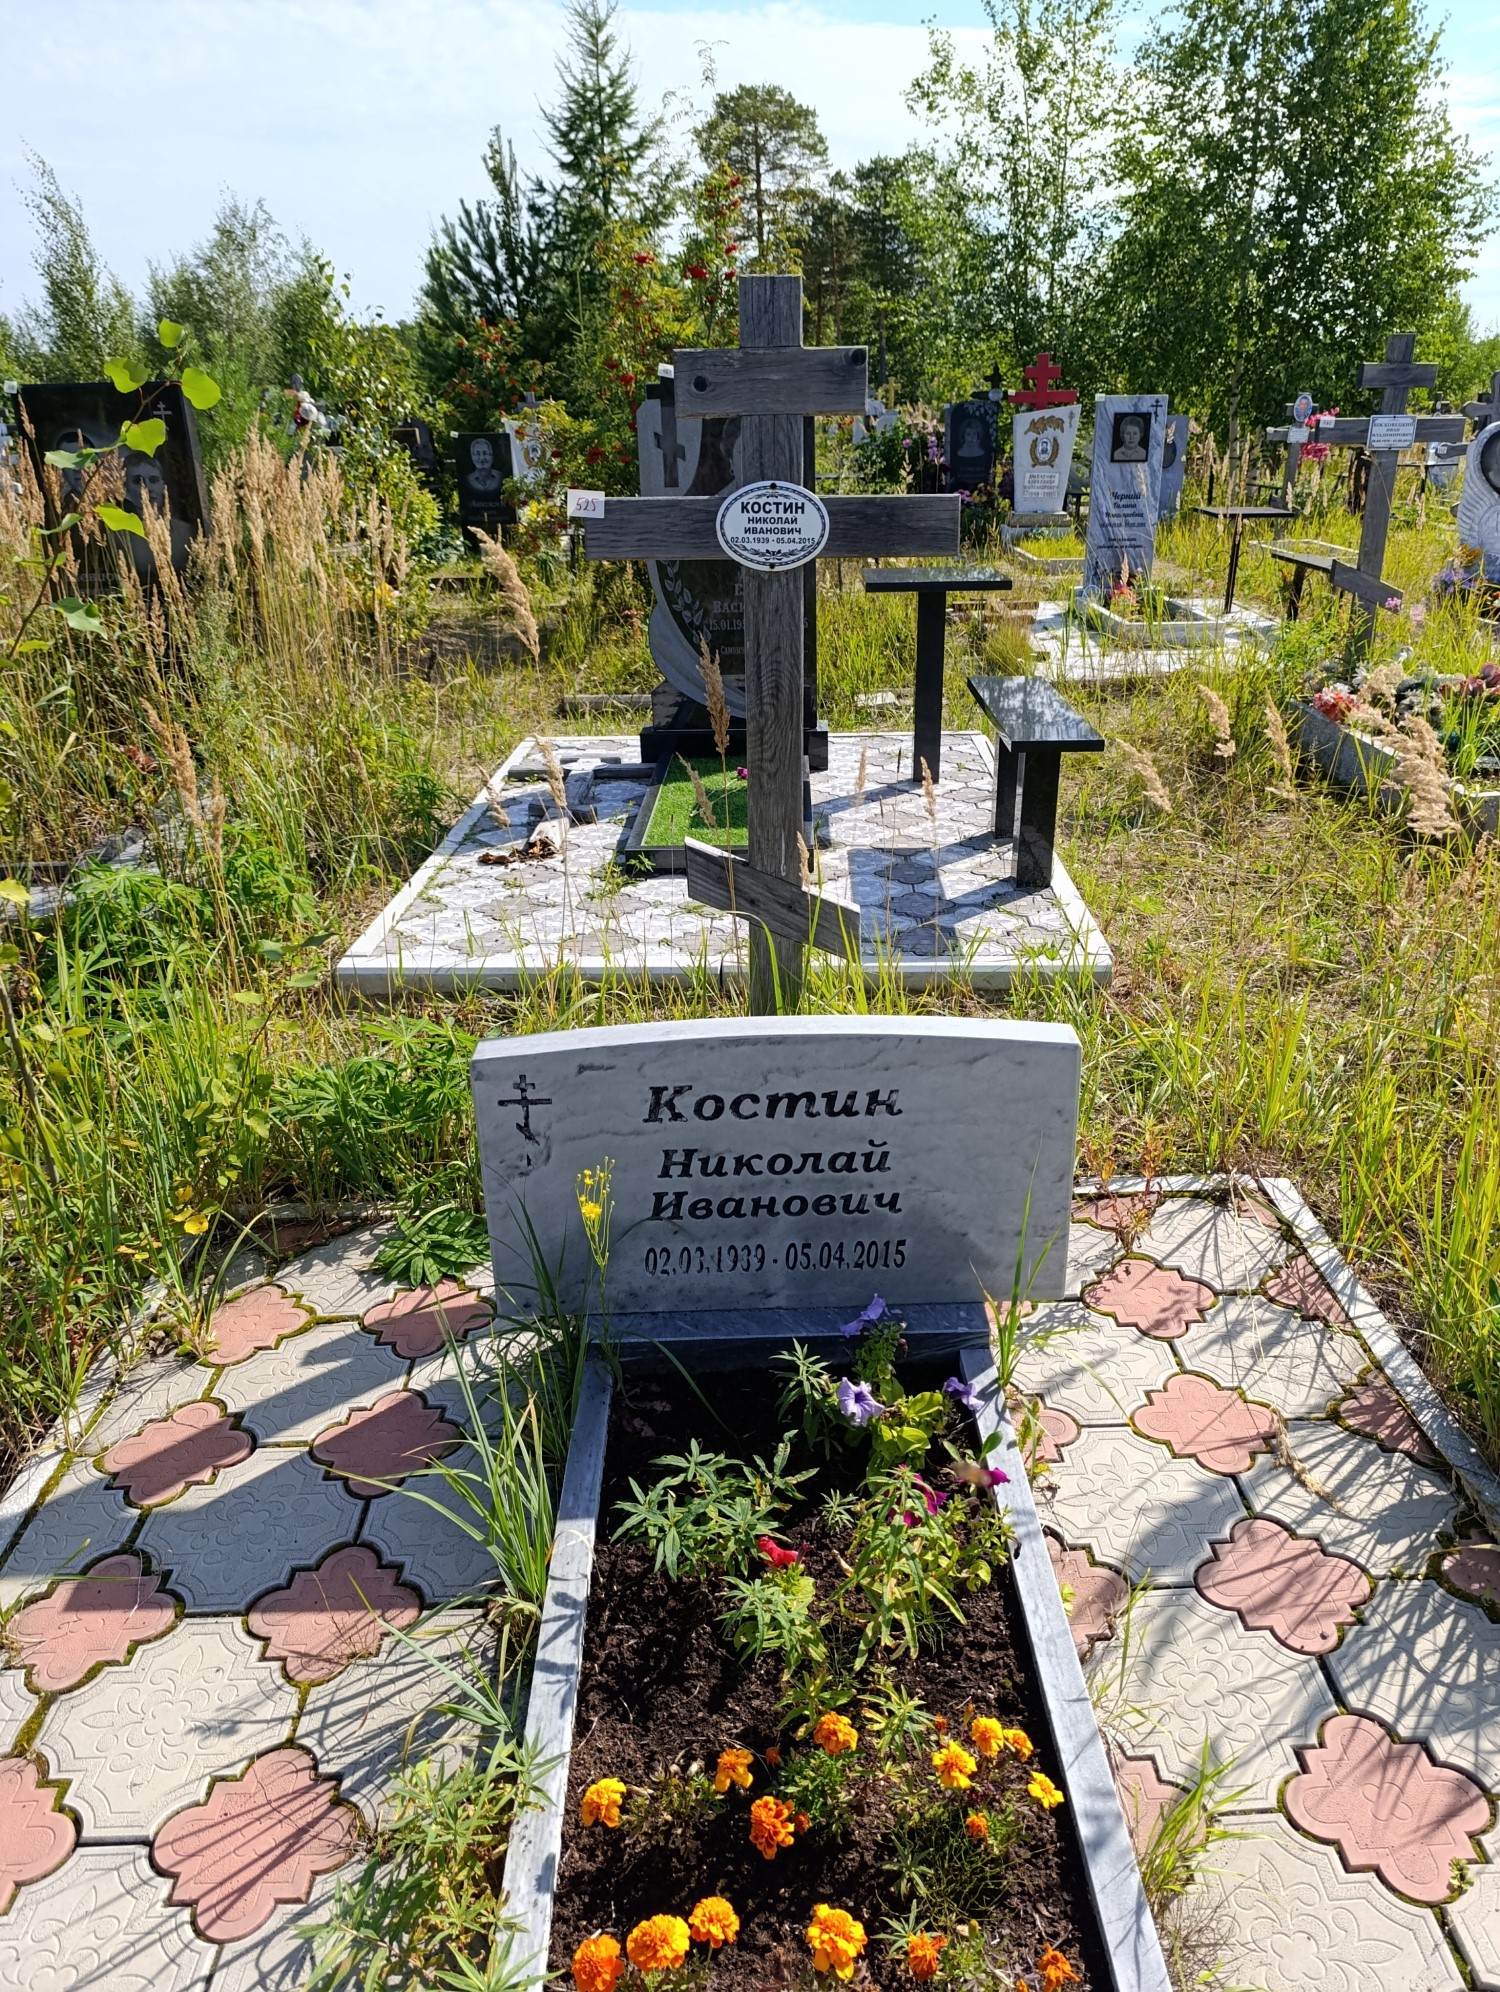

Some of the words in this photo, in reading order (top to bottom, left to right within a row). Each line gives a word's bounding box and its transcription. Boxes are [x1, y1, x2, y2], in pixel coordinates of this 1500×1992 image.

[576, 497, 599, 512] 525
[741, 501, 805, 514] КОСТИН
[747, 515, 798, 525] НИКОЛАЙ
[744, 526, 801, 535] ИВАНОВИЧ
[730, 536, 770, 544] 02.03.1939
[776, 537, 816, 545] 05.04.2015
[642, 1084, 904, 1124] Костин
[657, 1138, 892, 1179] Николай
[651, 1190, 903, 1221] Иванович
